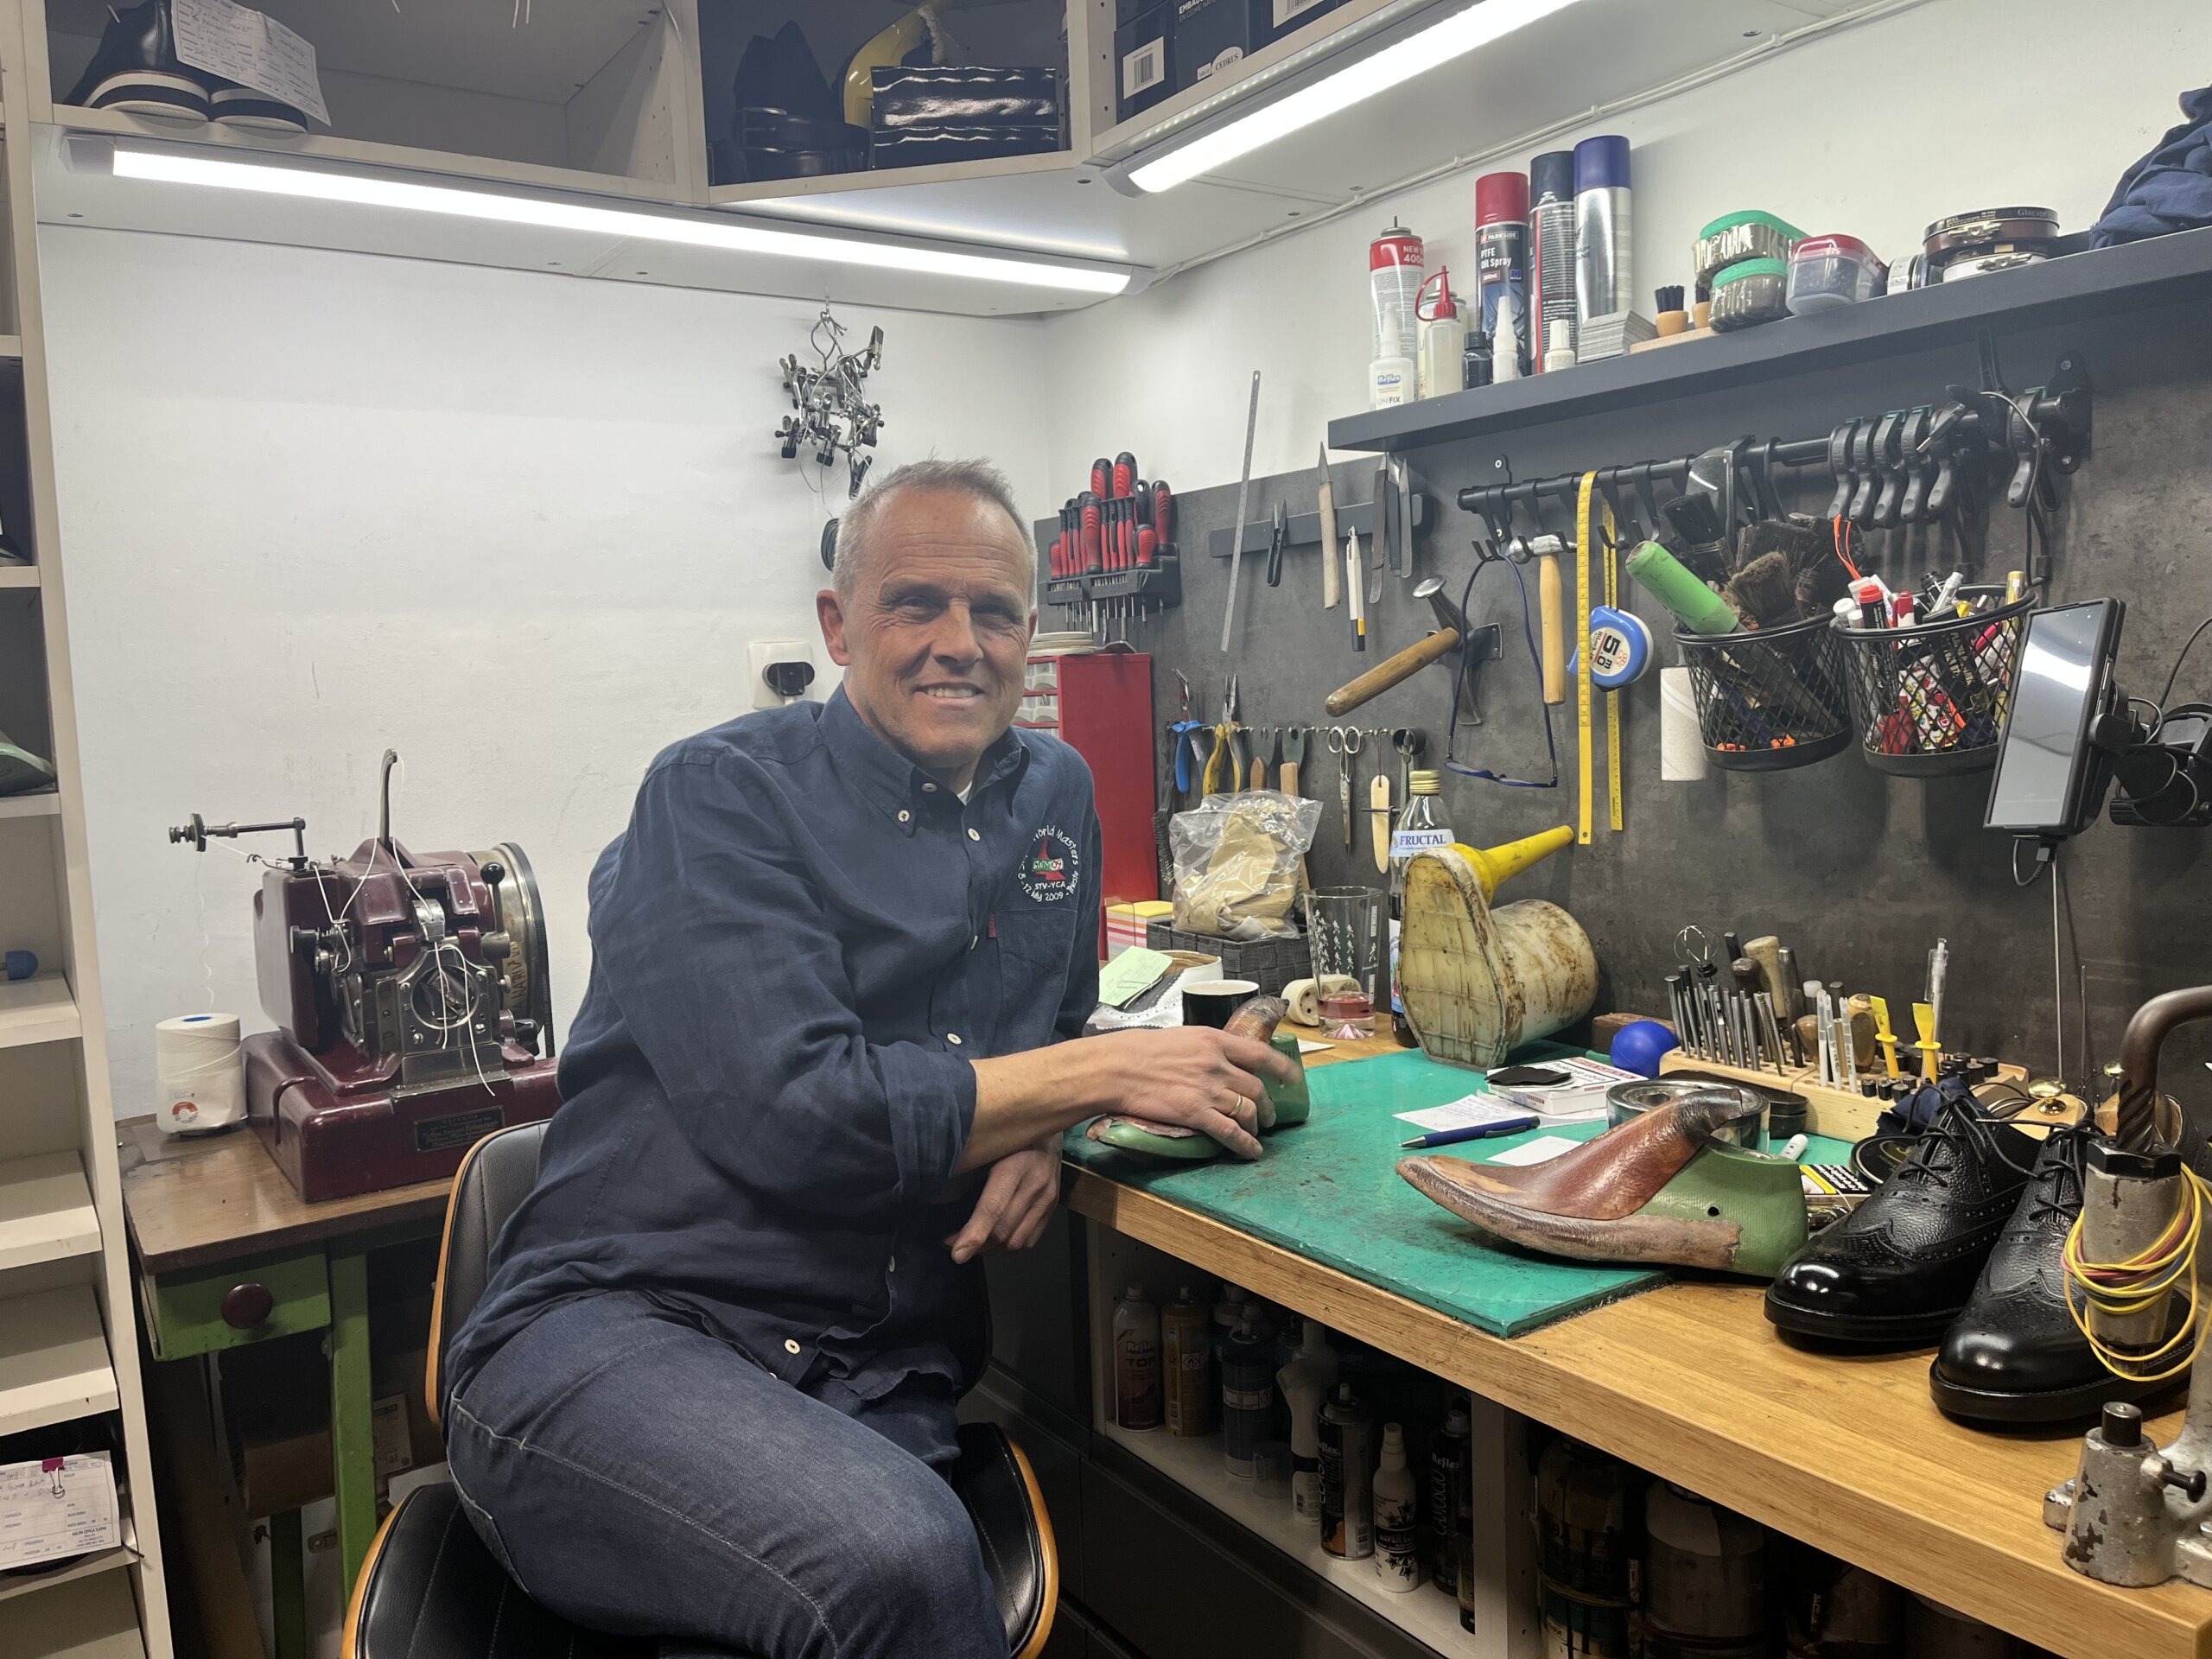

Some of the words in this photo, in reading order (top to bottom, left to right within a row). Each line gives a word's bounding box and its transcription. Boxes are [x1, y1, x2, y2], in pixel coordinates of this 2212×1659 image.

[1179, 0, 1204, 15] EMBAU
[1215, 53, 1239, 71] CEDRUS
[1487, 232, 1517, 241] PARKSIDE
[1403, 245, 1419, 254] NEW
[1480, 247, 1497, 260] PTFE
[1403, 253, 1424, 264] 400
[1480, 258, 1491, 270] Oil
[1490, 257, 1512, 269] Spray
[1400, 834, 1447, 846] FRUCTAL
[1056, 829, 1079, 866] Masters
[1045, 891, 1064, 901] 2009
[1126, 1356, 1155, 1368] TOP
